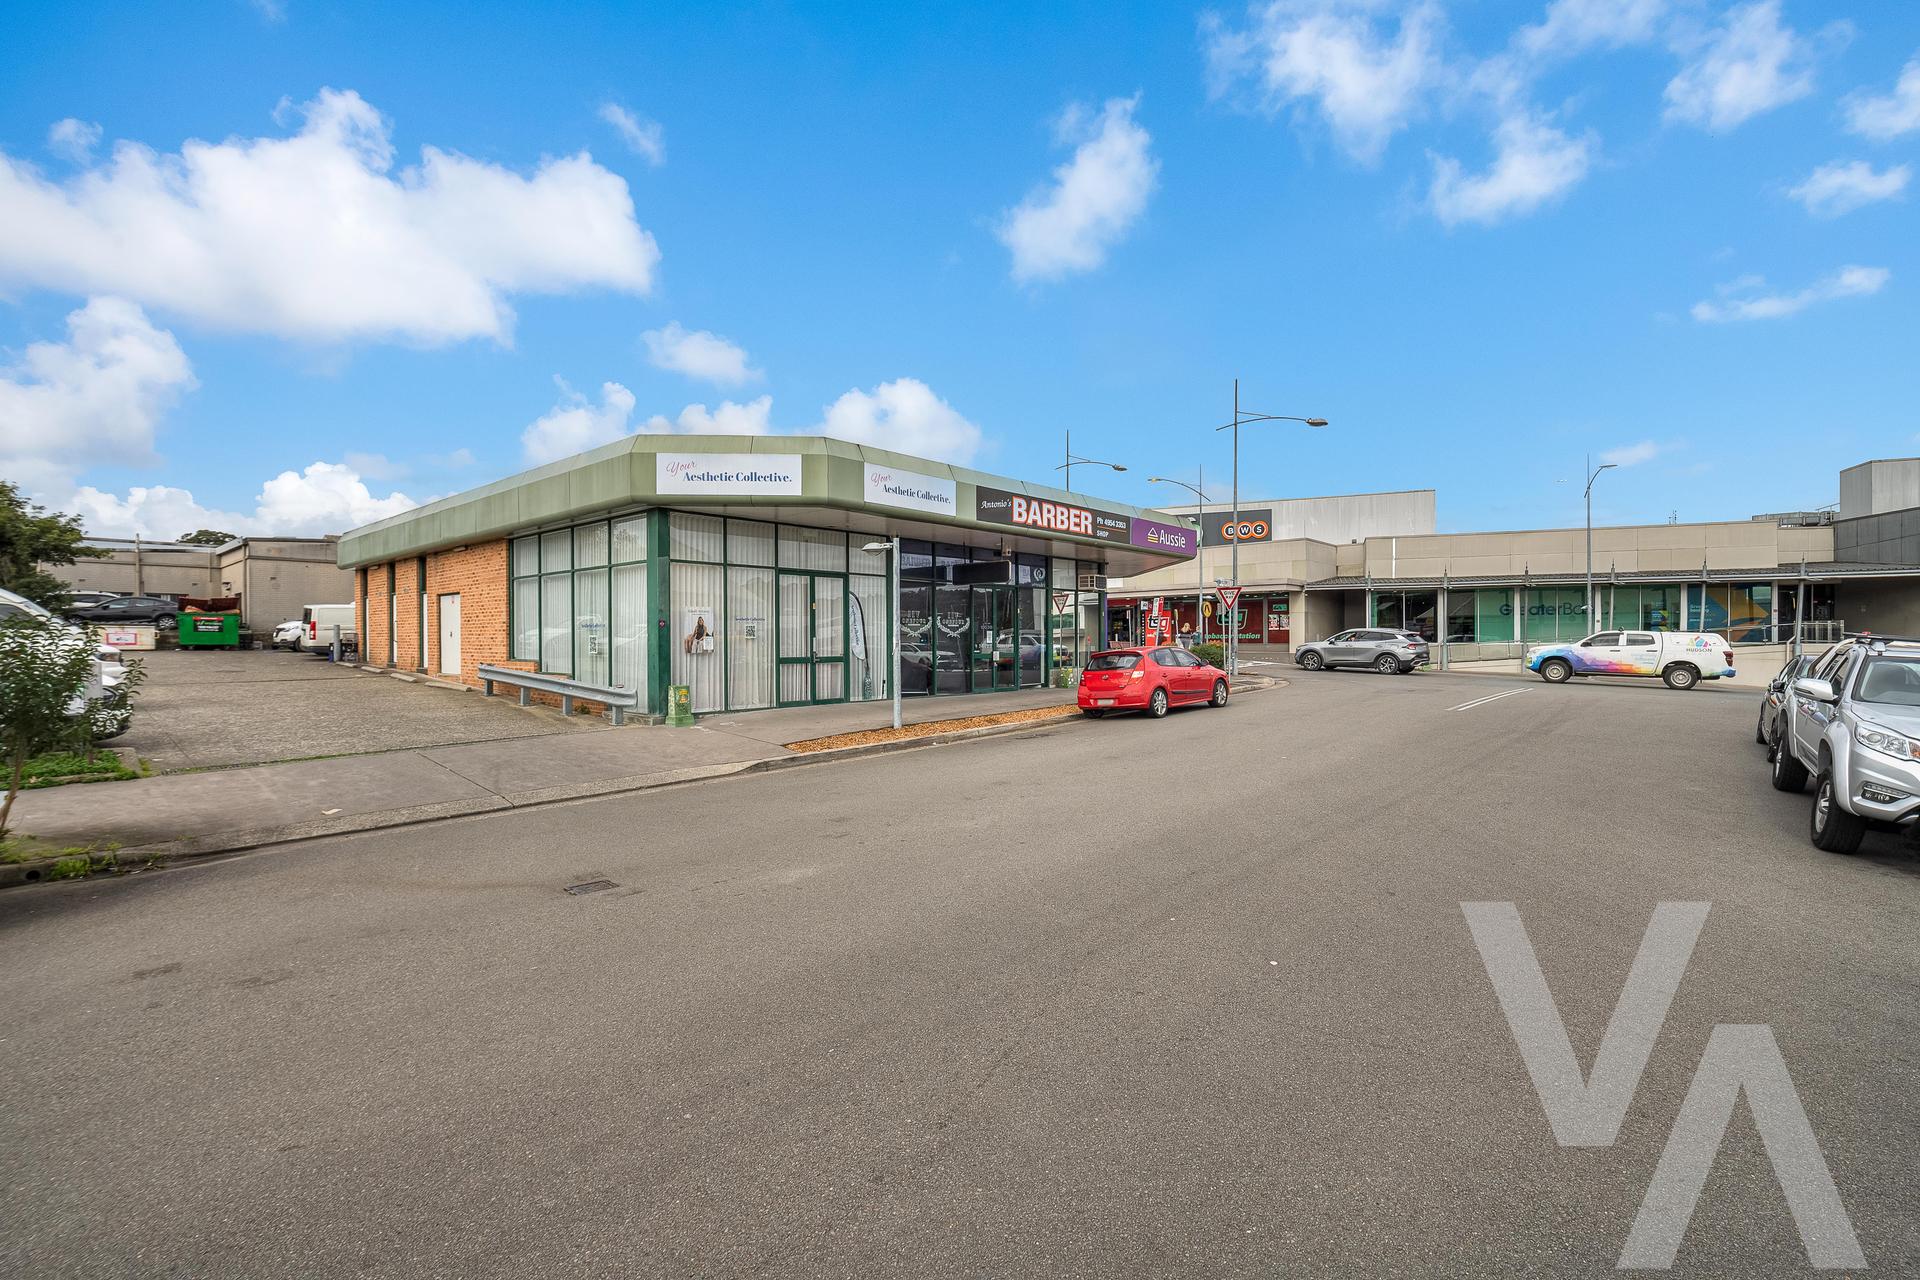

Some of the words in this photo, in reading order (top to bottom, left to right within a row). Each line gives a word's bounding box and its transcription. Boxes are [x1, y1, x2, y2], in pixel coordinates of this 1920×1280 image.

[683, 472, 734, 482] Aesthetic
[735, 472, 792, 483] Collective.
[882, 484, 916, 498] Aesthetic
[916, 489, 951, 504] Collective.
[981, 499, 1012, 509] Antonio's
[1012, 495, 1093, 535] BARBER
[1096, 516, 1104, 525] Ph
[1096, 529, 1109, 538] SHOP
[1226, 524, 1264, 536] BWS
[1160, 529, 1186, 548] Aussie
